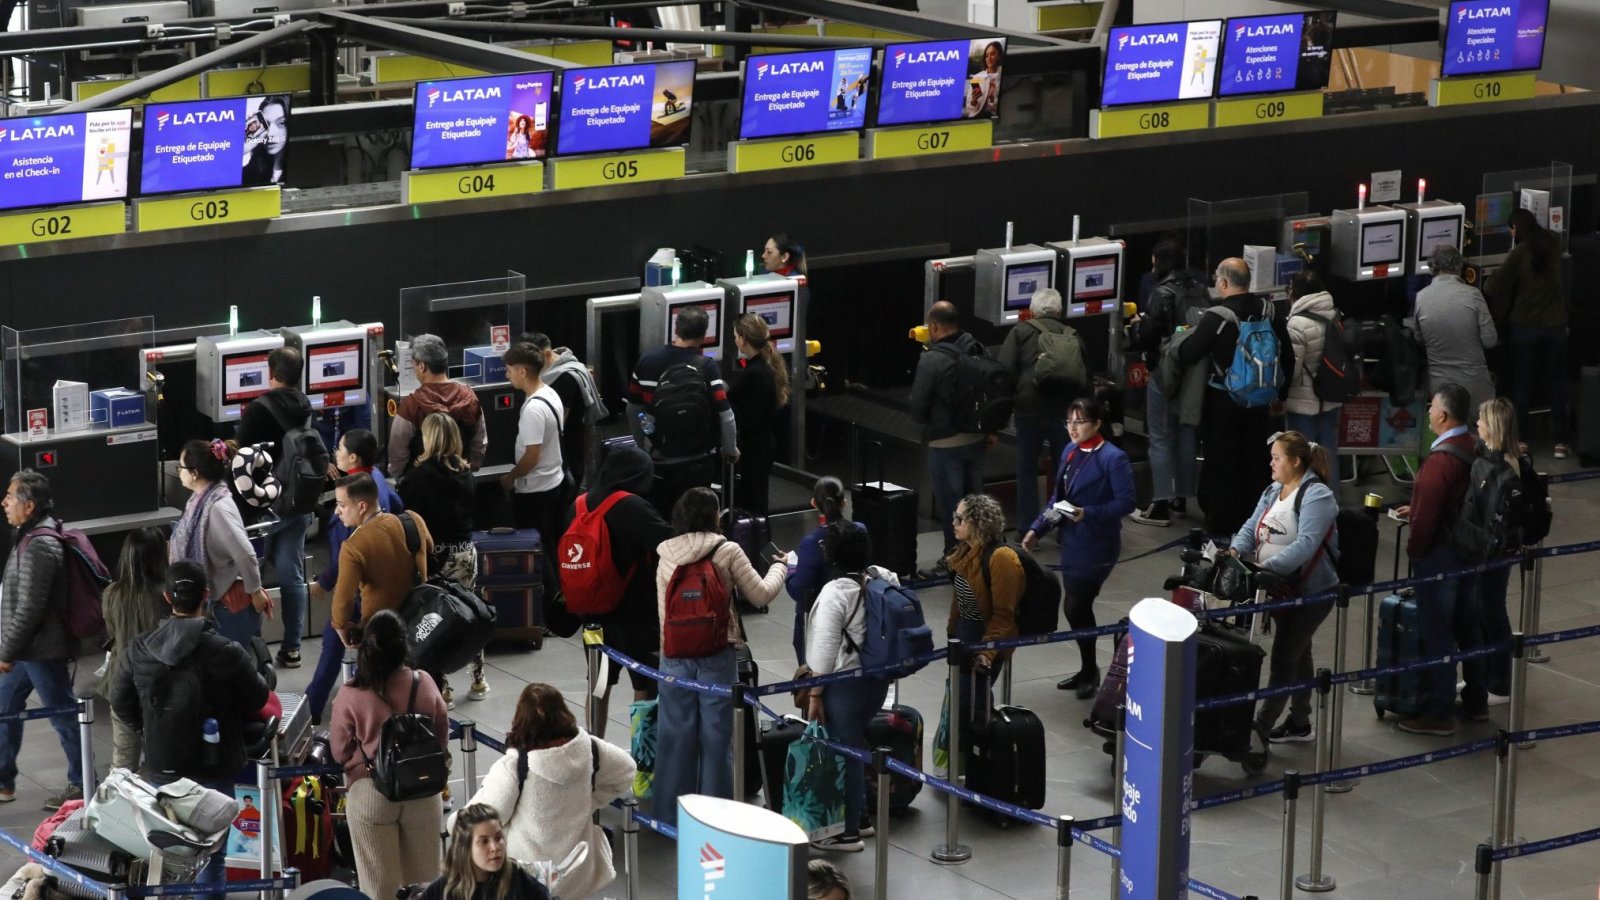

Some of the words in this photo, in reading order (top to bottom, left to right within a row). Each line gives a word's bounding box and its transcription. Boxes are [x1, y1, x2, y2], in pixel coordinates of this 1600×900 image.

[1468, 7, 1511, 19] LATAM
[1247, 24, 1294, 36] LATAM
[1466, 27, 1496, 35] Atenciones
[1130, 33, 1179, 47] LATAM
[1467, 36, 1495, 46] Especiales
[1246, 45, 1278, 54] Atenciones
[908, 50, 960, 64] LATAM
[1246, 54, 1277, 64] Especiales
[771, 61, 824, 76] LATAM
[1115, 61, 1138, 71] Entrega
[1139, 60, 1147, 69] de
[1148, 59, 1174, 70] Equipaje
[588, 74, 645, 90] LATAM
[1127, 70, 1161, 80] Etiquetado
[891, 78, 917, 89] Entrega
[918, 78, 927, 87] de
[927, 77, 955, 88] Equipaje
[1474, 82, 1501, 98] G10
[443, 87, 501, 103] LATAM
[754, 91, 781, 102] Entrega
[781, 90, 790, 99] de
[791, 88, 820, 101] Equipaje
[905, 88, 941, 99] Etiquetado
[571, 107, 599, 118] Entrega
[600, 106, 610, 115] de
[610, 104, 641, 116] Equipaje
[768, 100, 805, 111] Etiquetado
[1256, 102, 1285, 119] G09
[172, 109, 235, 126] LATAM
[425, 118, 455, 131] Entrega
[455, 117, 464, 127] de
[465, 116, 497, 130] Equipaje
[586, 115, 626, 127] Etiquetado
[1139, 112, 1170, 130] G08
[10, 125, 75, 142] LATAM
[441, 128, 481, 141] Etiquetado
[155, 143, 185, 156] Entrega
[187, 142, 197, 151] de
[198, 140, 231, 154] Equipaje
[917, 132, 950, 150] G07
[172, 153, 215, 165] Etiquetado
[781, 143, 815, 163] G06
[12, 155, 54, 168] Asistencia
[4, 170, 15, 179] en
[16, 168, 24, 178] el
[24, 166, 60, 177] Check-in
[602, 160, 639, 180] G05
[458, 174, 495, 194] G04
[190, 200, 229, 221] G03
[31, 216, 72, 237] G02
